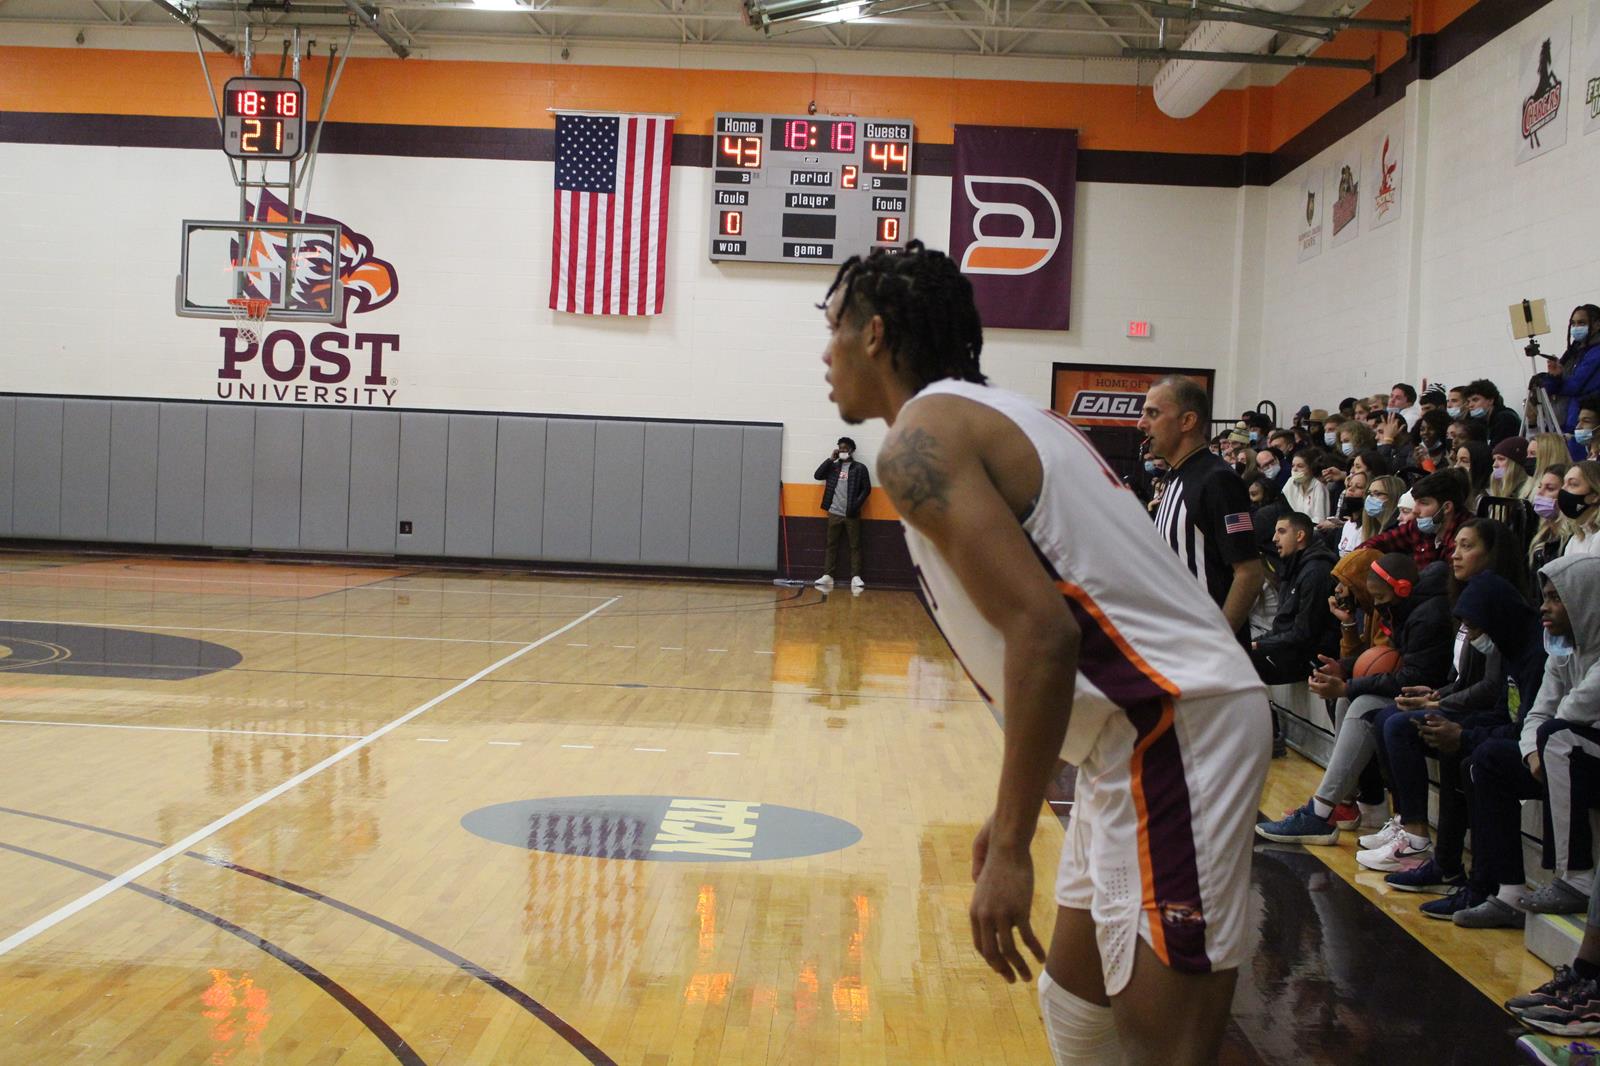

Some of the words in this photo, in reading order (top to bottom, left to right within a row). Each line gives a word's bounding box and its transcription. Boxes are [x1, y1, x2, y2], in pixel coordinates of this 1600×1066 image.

[237, 91, 297, 116] 18:18
[724, 118, 757, 134] Home
[866, 123, 908, 139] Guests
[242, 119, 282, 152] 21
[723, 137, 761, 168] 43
[870, 143, 908, 172] 44
[792, 171, 831, 186] period
[842, 165, 857, 188] 2
[718, 191, 745, 205] fouls
[791, 194, 829, 208] player
[875, 198, 903, 211] fouls
[726, 212, 740, 235] 0
[883, 218, 898, 241] 0
[719, 242, 741, 253] won
[793, 245, 823, 257] game
[1128, 320, 1149, 337] EXIT
[218, 327, 400, 384] POST
[1096, 378, 1128, 388] HOME
[1130, 380, 1144, 389] OF
[217, 382, 398, 406] UNIVERSITY
[1077, 396, 1144, 415] EAGL
